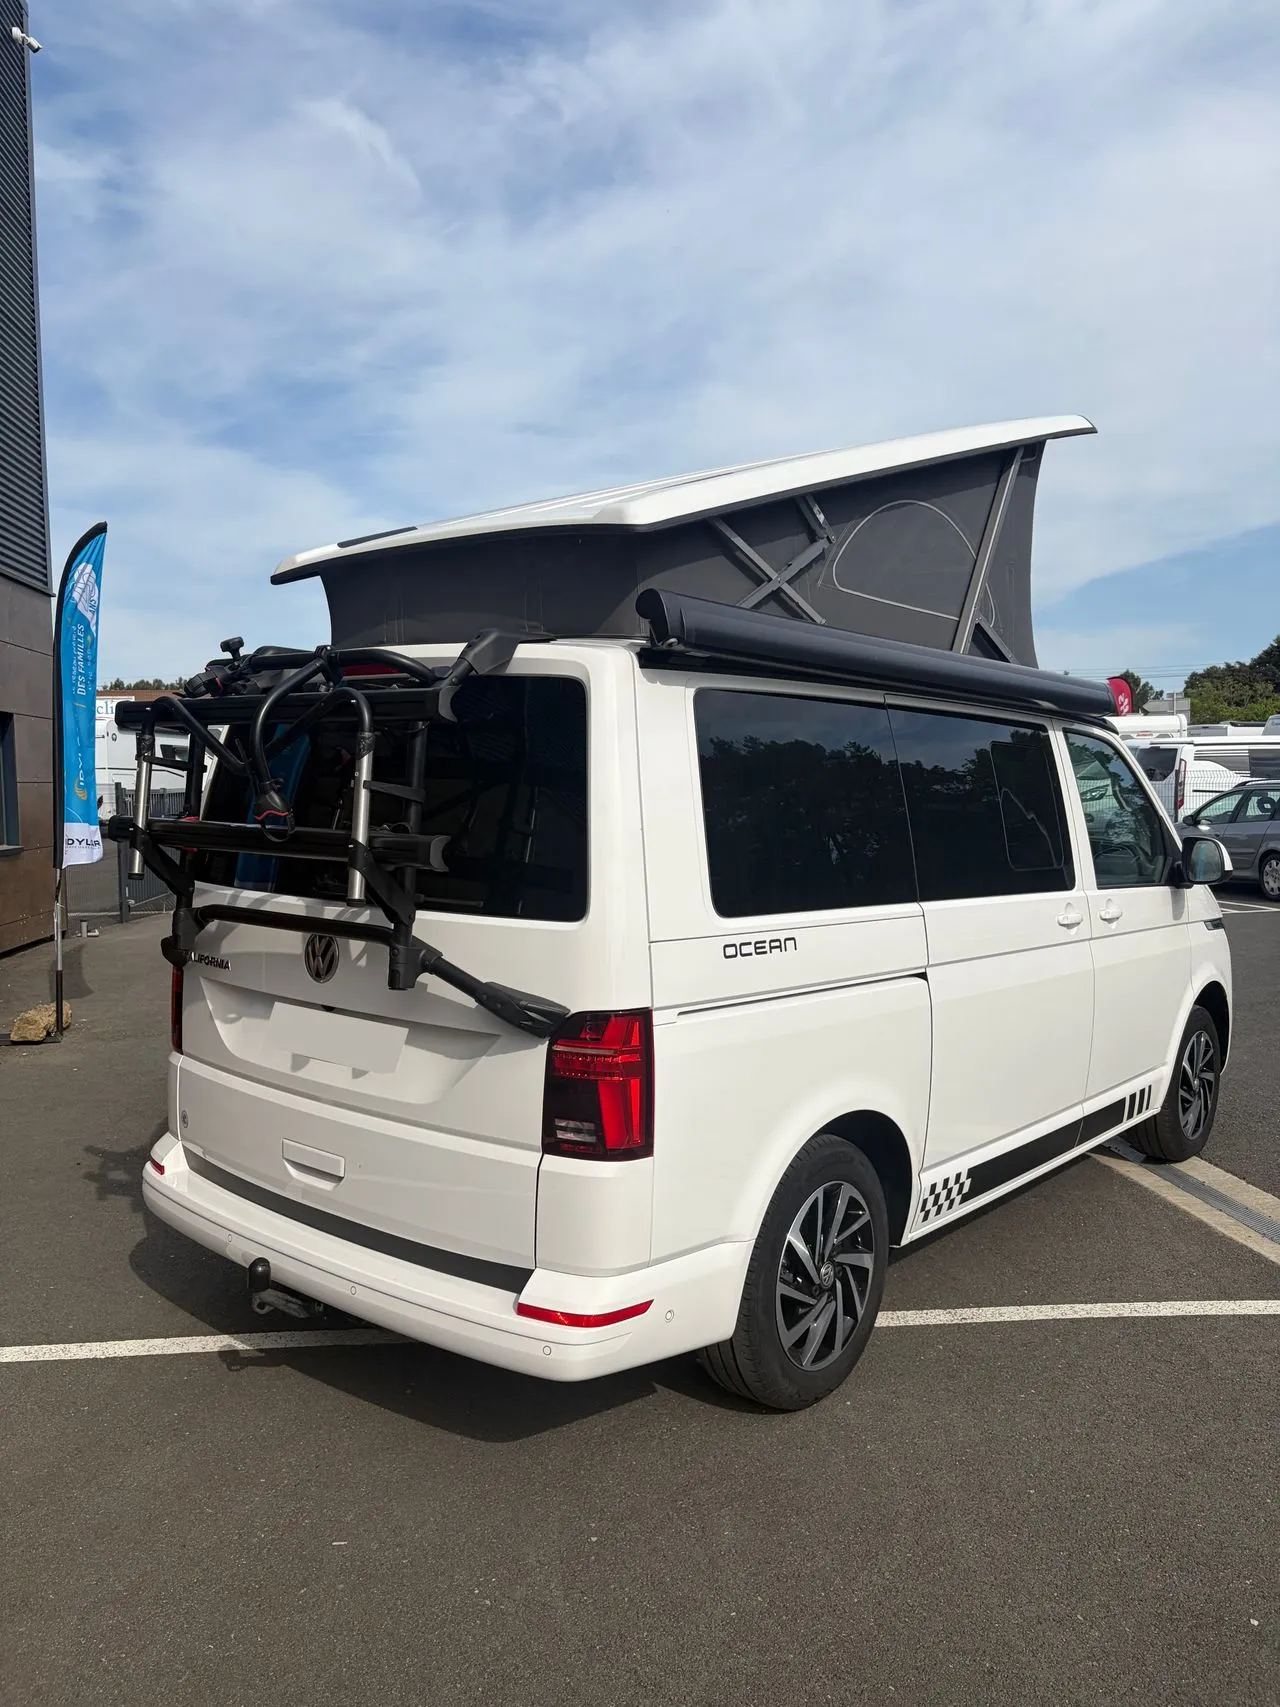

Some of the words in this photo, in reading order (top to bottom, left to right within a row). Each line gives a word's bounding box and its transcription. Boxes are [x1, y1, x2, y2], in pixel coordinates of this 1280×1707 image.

[77, 623, 86, 674] FAMILLES
[77, 675, 86, 696] DES
[723, 937, 797, 959] OCEAN
